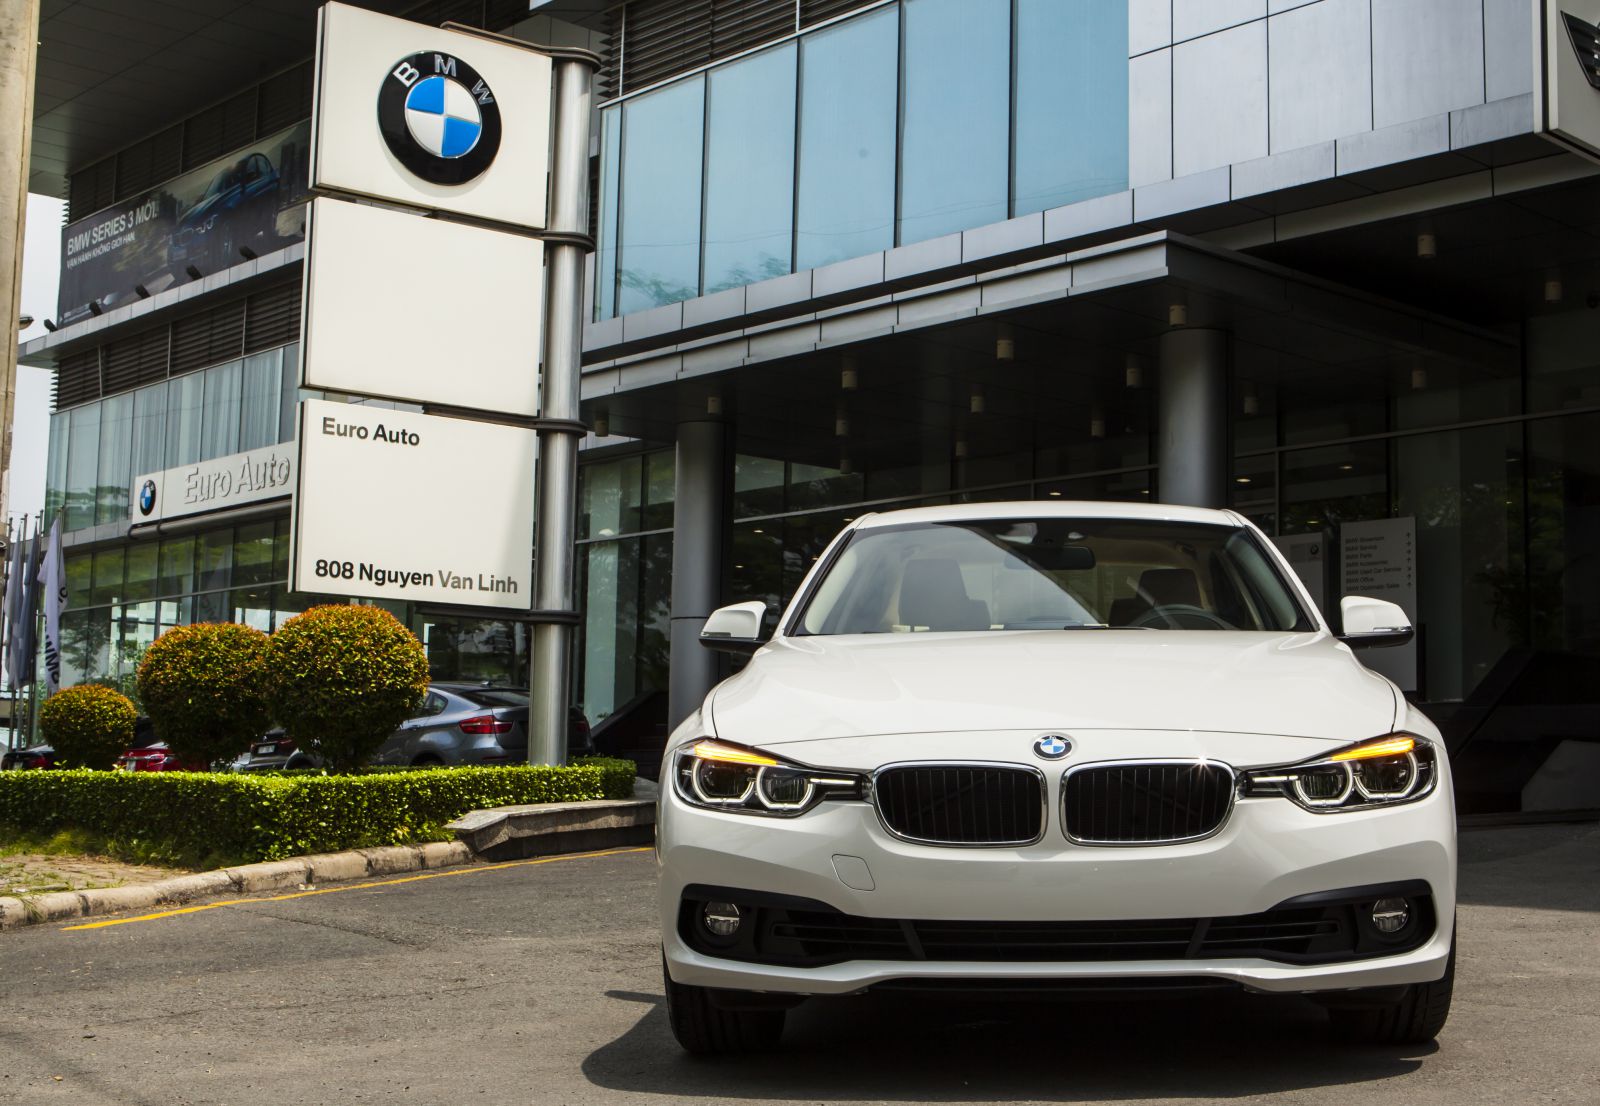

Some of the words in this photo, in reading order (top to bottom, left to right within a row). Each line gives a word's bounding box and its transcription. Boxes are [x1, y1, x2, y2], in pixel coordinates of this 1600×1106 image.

[393, 54, 494, 105] BMW
[67, 230, 91, 256] BMW
[92, 214, 127, 244] SERIES
[128, 210, 134, 228] 3
[322, 416, 369, 440] Euro
[373, 424, 420, 446] Auto
[184, 466, 232, 505] Euro
[235, 453, 291, 495] Auto
[315, 559, 354, 580] 808
[359, 563, 434, 588] Nguyen
[438, 570, 473, 589] Van
[478, 573, 518, 593] Linh
